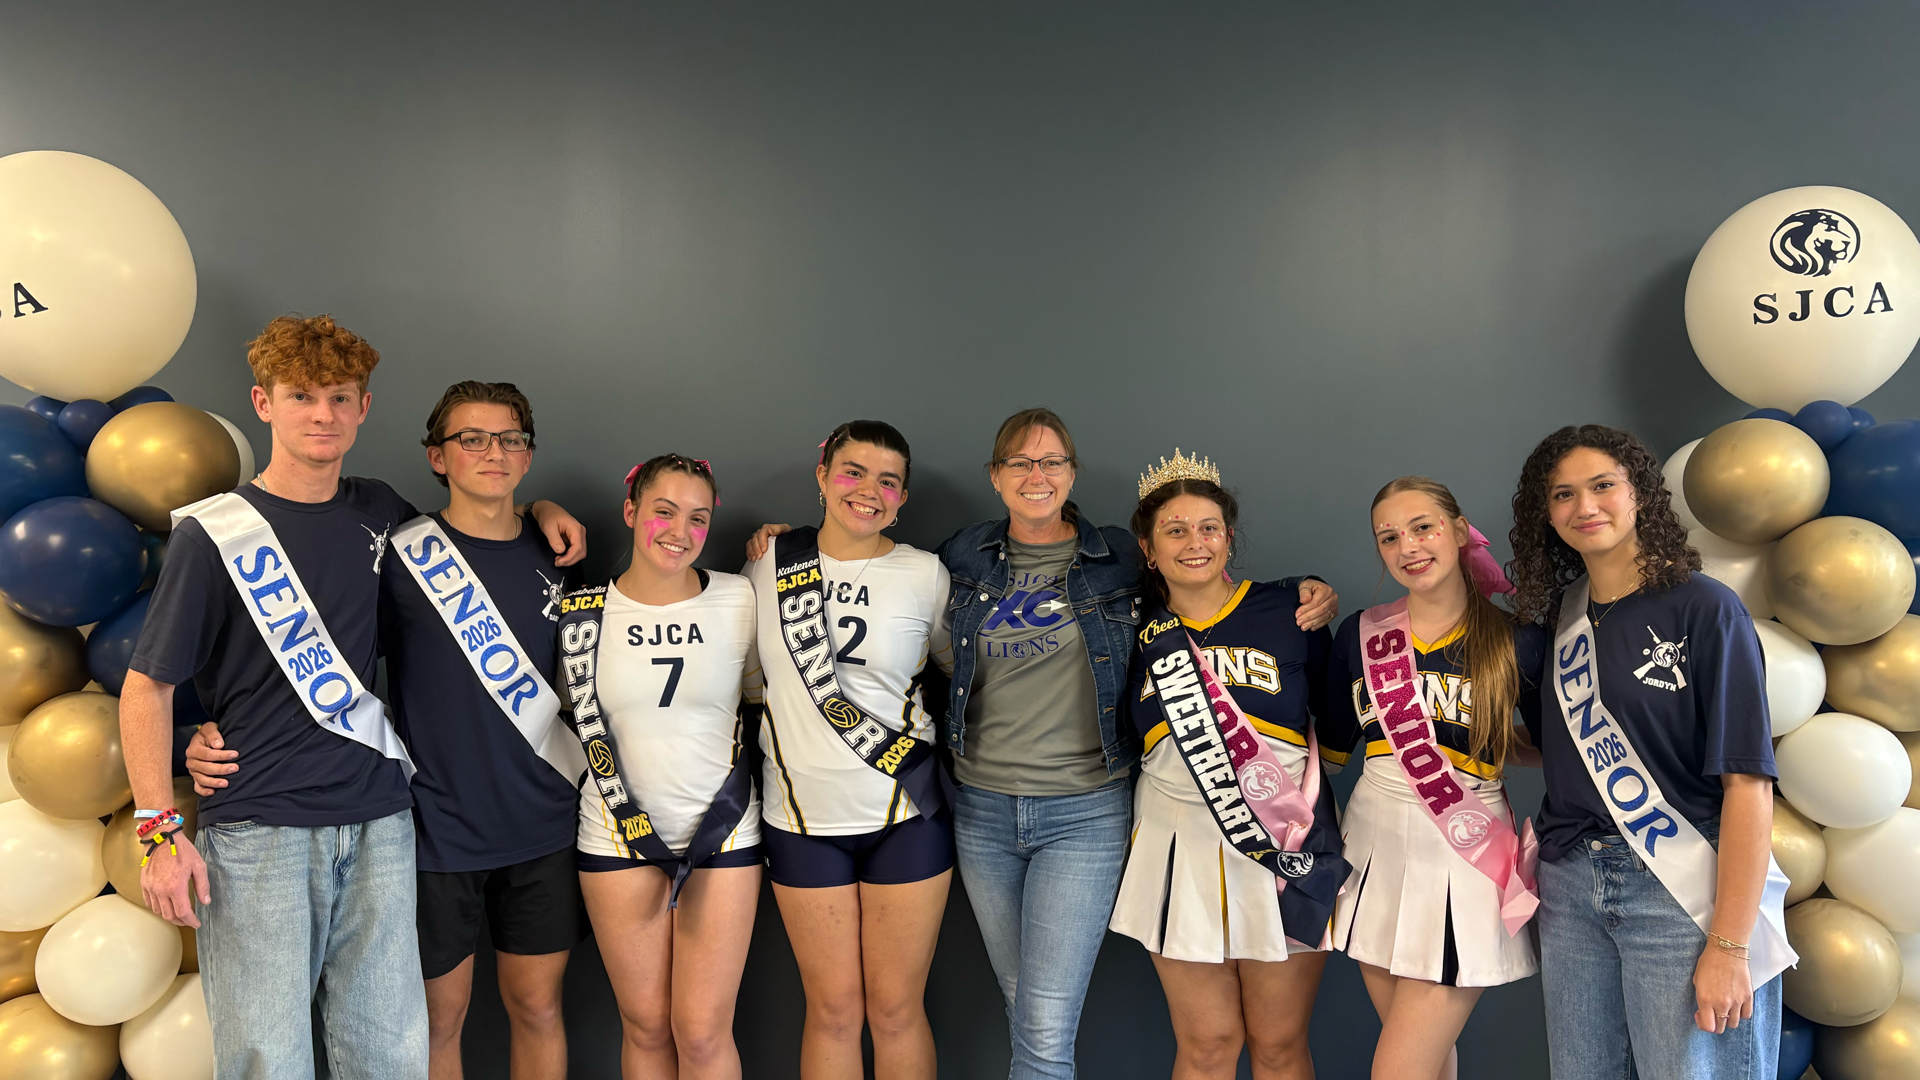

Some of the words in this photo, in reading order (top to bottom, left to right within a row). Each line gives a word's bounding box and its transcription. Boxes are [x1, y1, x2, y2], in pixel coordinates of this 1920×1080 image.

[1753, 281, 1894, 325] SJCA
[776, 568, 822, 592] SJCA
[777, 558, 820, 577] Kadence
[561, 595, 604, 614] SJCA
[823, 580, 870, 606] JCA
[981, 590, 1063, 631] XC
[461, 615, 502, 653] 2026
[628, 623, 704, 646] SJCA
[836, 615, 868, 667] 2
[1139, 617, 1180, 644] Cheer
[288, 641, 334, 683] 2026
[651, 657, 684, 707] 7
[1642, 677, 1677, 692] JORDYN
[1366, 628, 1464, 817] SENIOR
[876, 736, 916, 775] 2026
[1152, 650, 1267, 845] SWEETHEART
[1586, 732, 1628, 773] 2026
[622, 813, 652, 841] 2026
